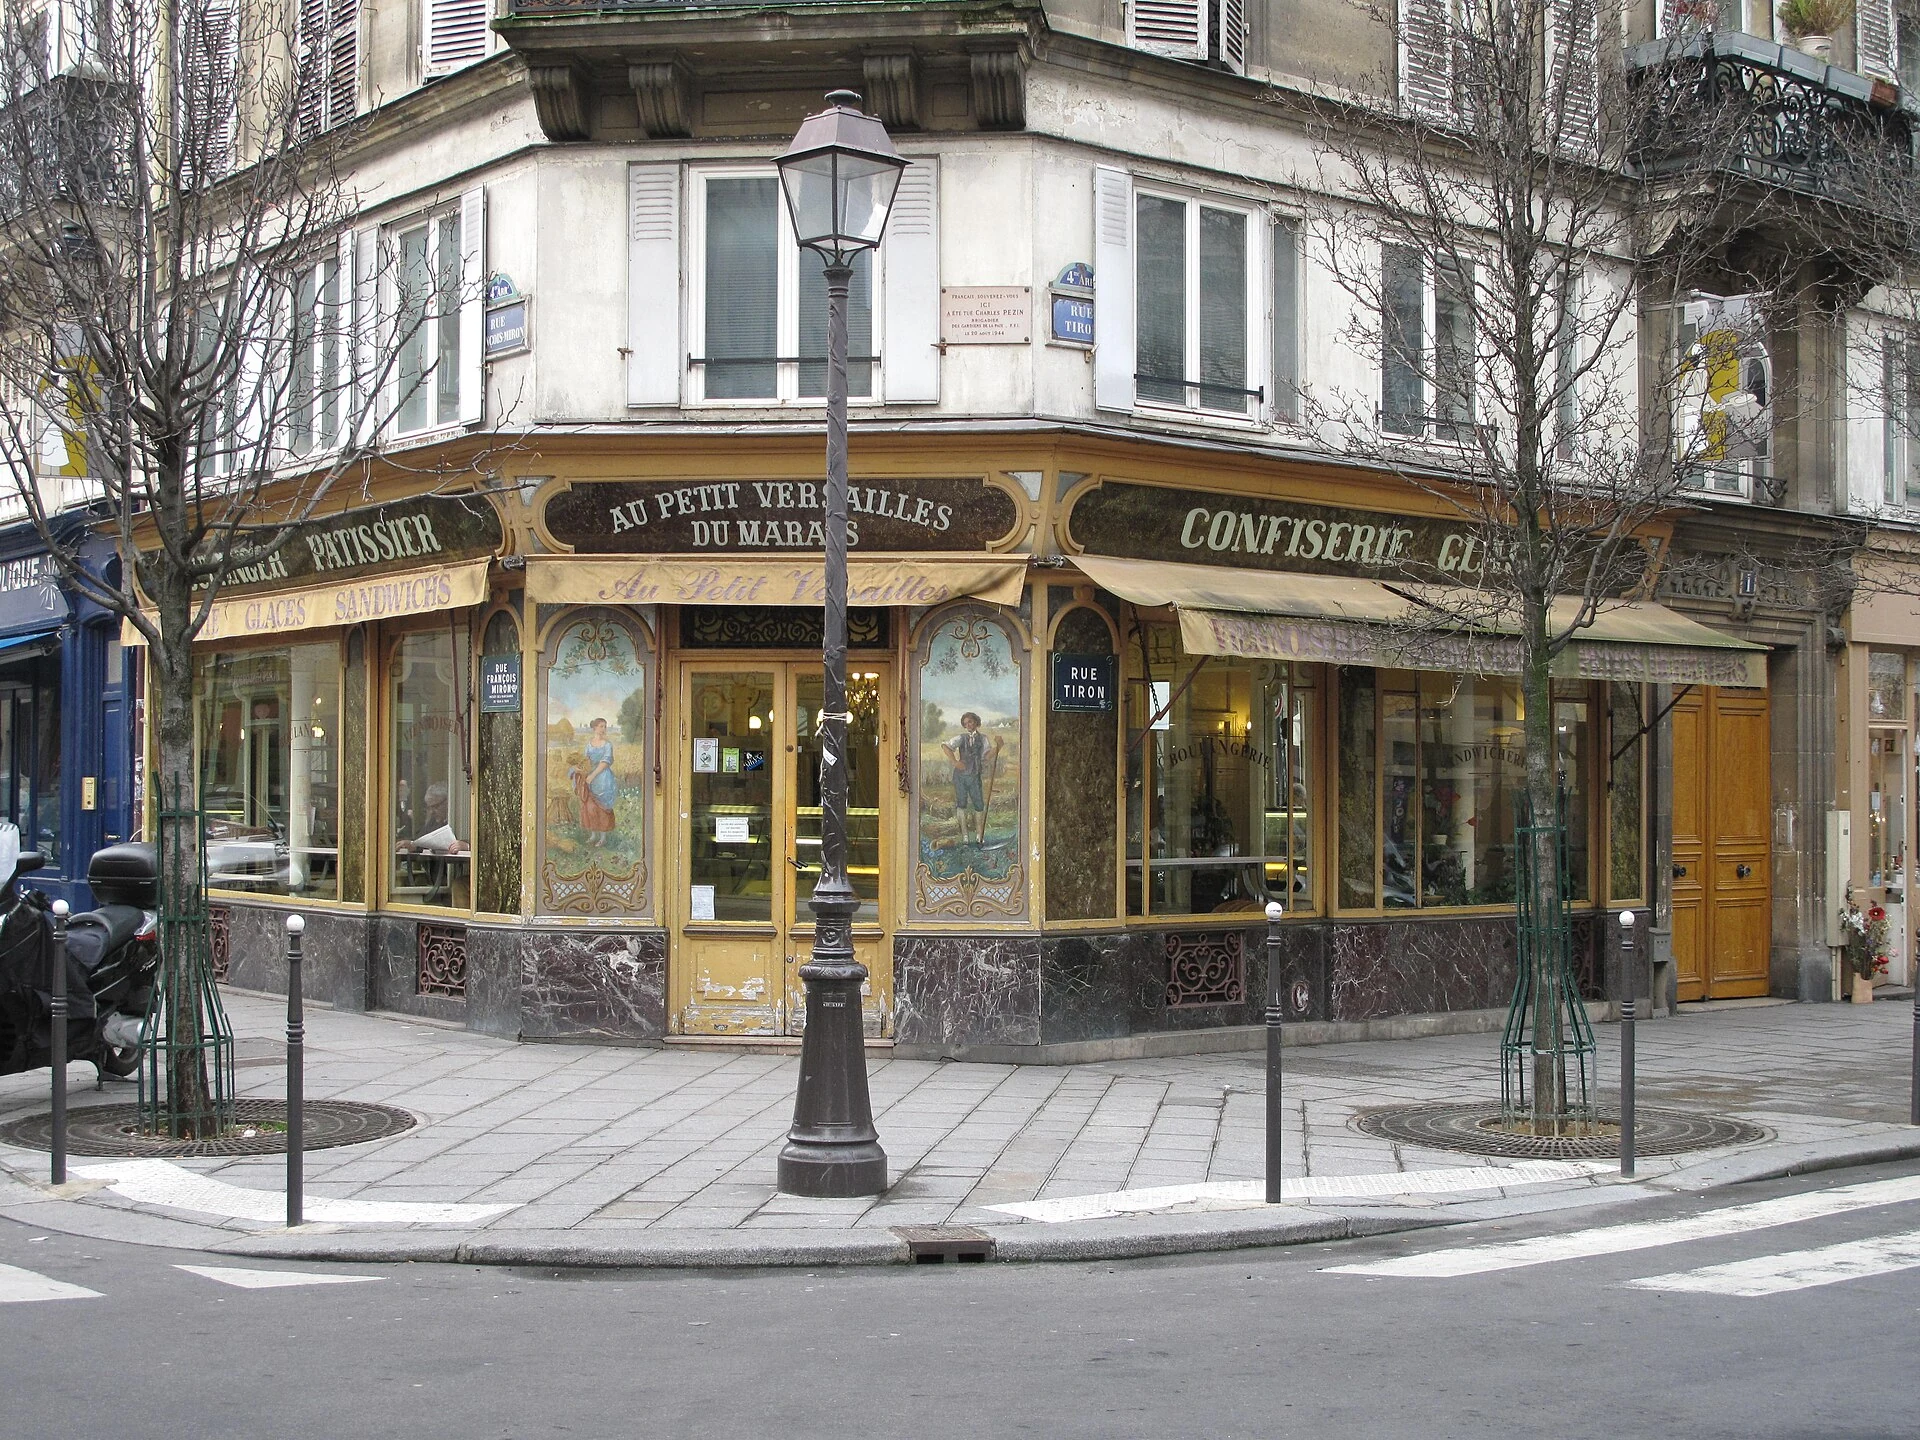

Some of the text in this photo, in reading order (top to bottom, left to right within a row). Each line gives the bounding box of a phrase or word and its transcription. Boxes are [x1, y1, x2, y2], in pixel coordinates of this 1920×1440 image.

[1071, 305, 1093, 319] RUE
[490, 315, 506, 331] RUE
[1065, 320, 1091, 335] TIRO
[609, 499, 648, 533] AU
[655, 482, 740, 519] PETIT
[691, 520, 859, 546] DU MARAS
[1180, 507, 1413, 565] CONFISERIE
[599, 566, 950, 601] Au Petit Vesailles
[245, 597, 305, 630] GLACES
[334, 571, 451, 622] SANDWICHS
[495, 663, 508, 673] RUE
[1071, 666, 1097, 681] RUE
[486, 673, 517, 684] FRANÇOIS
[491, 684, 512, 694] MIRON
[1063, 684, 1105, 699] TIRON
